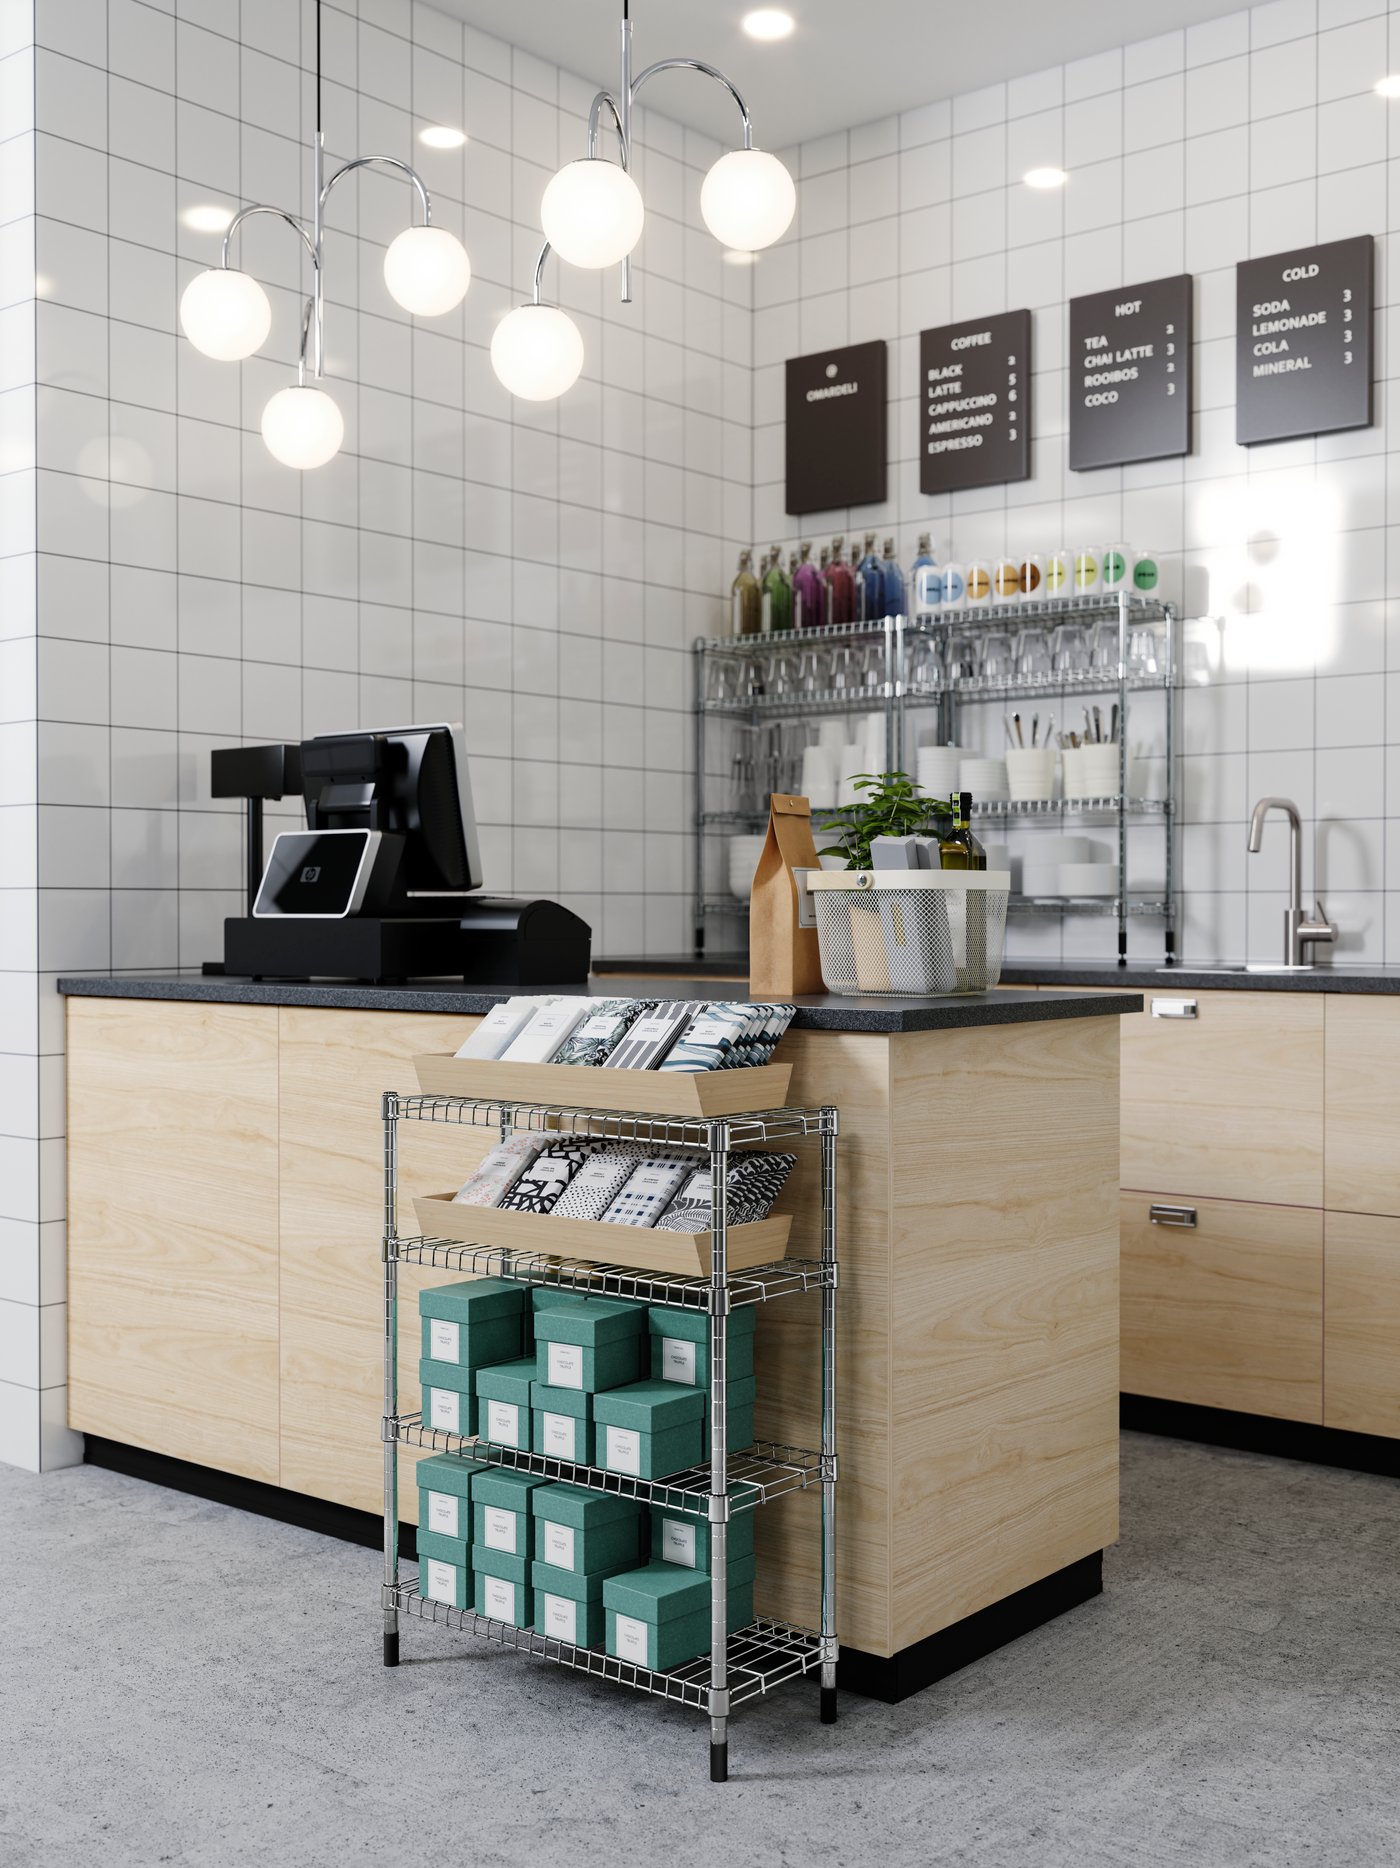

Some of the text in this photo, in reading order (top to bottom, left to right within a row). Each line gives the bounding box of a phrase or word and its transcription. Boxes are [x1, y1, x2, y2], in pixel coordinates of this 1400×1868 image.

[1282, 264, 1319, 282] COLD
[1115, 300, 1142, 317] HOT
[1253, 289, 1352, 317] SODA 3
[1253, 309, 1352, 336] LEMONADE 3
[951, 332, 992, 351] COFFEE
[1084, 335, 1108, 350] TEA
[1253, 330, 1352, 356] COLA 3
[1084, 343, 1175, 368] CHAI LATTE 3
[1253, 351, 1352, 377] MINERAL 3
[928, 364, 963, 381] BLACK
[1084, 367, 1138, 388] ROOIBOS
[928, 382, 962, 398] LATTE
[1084, 382, 1175, 407] COCO 3
[928, 389, 1017, 416] CAPPUCCINO 6
[928, 413, 993, 435] AMERICANO
[928, 434, 983, 454] ESPRESSO
